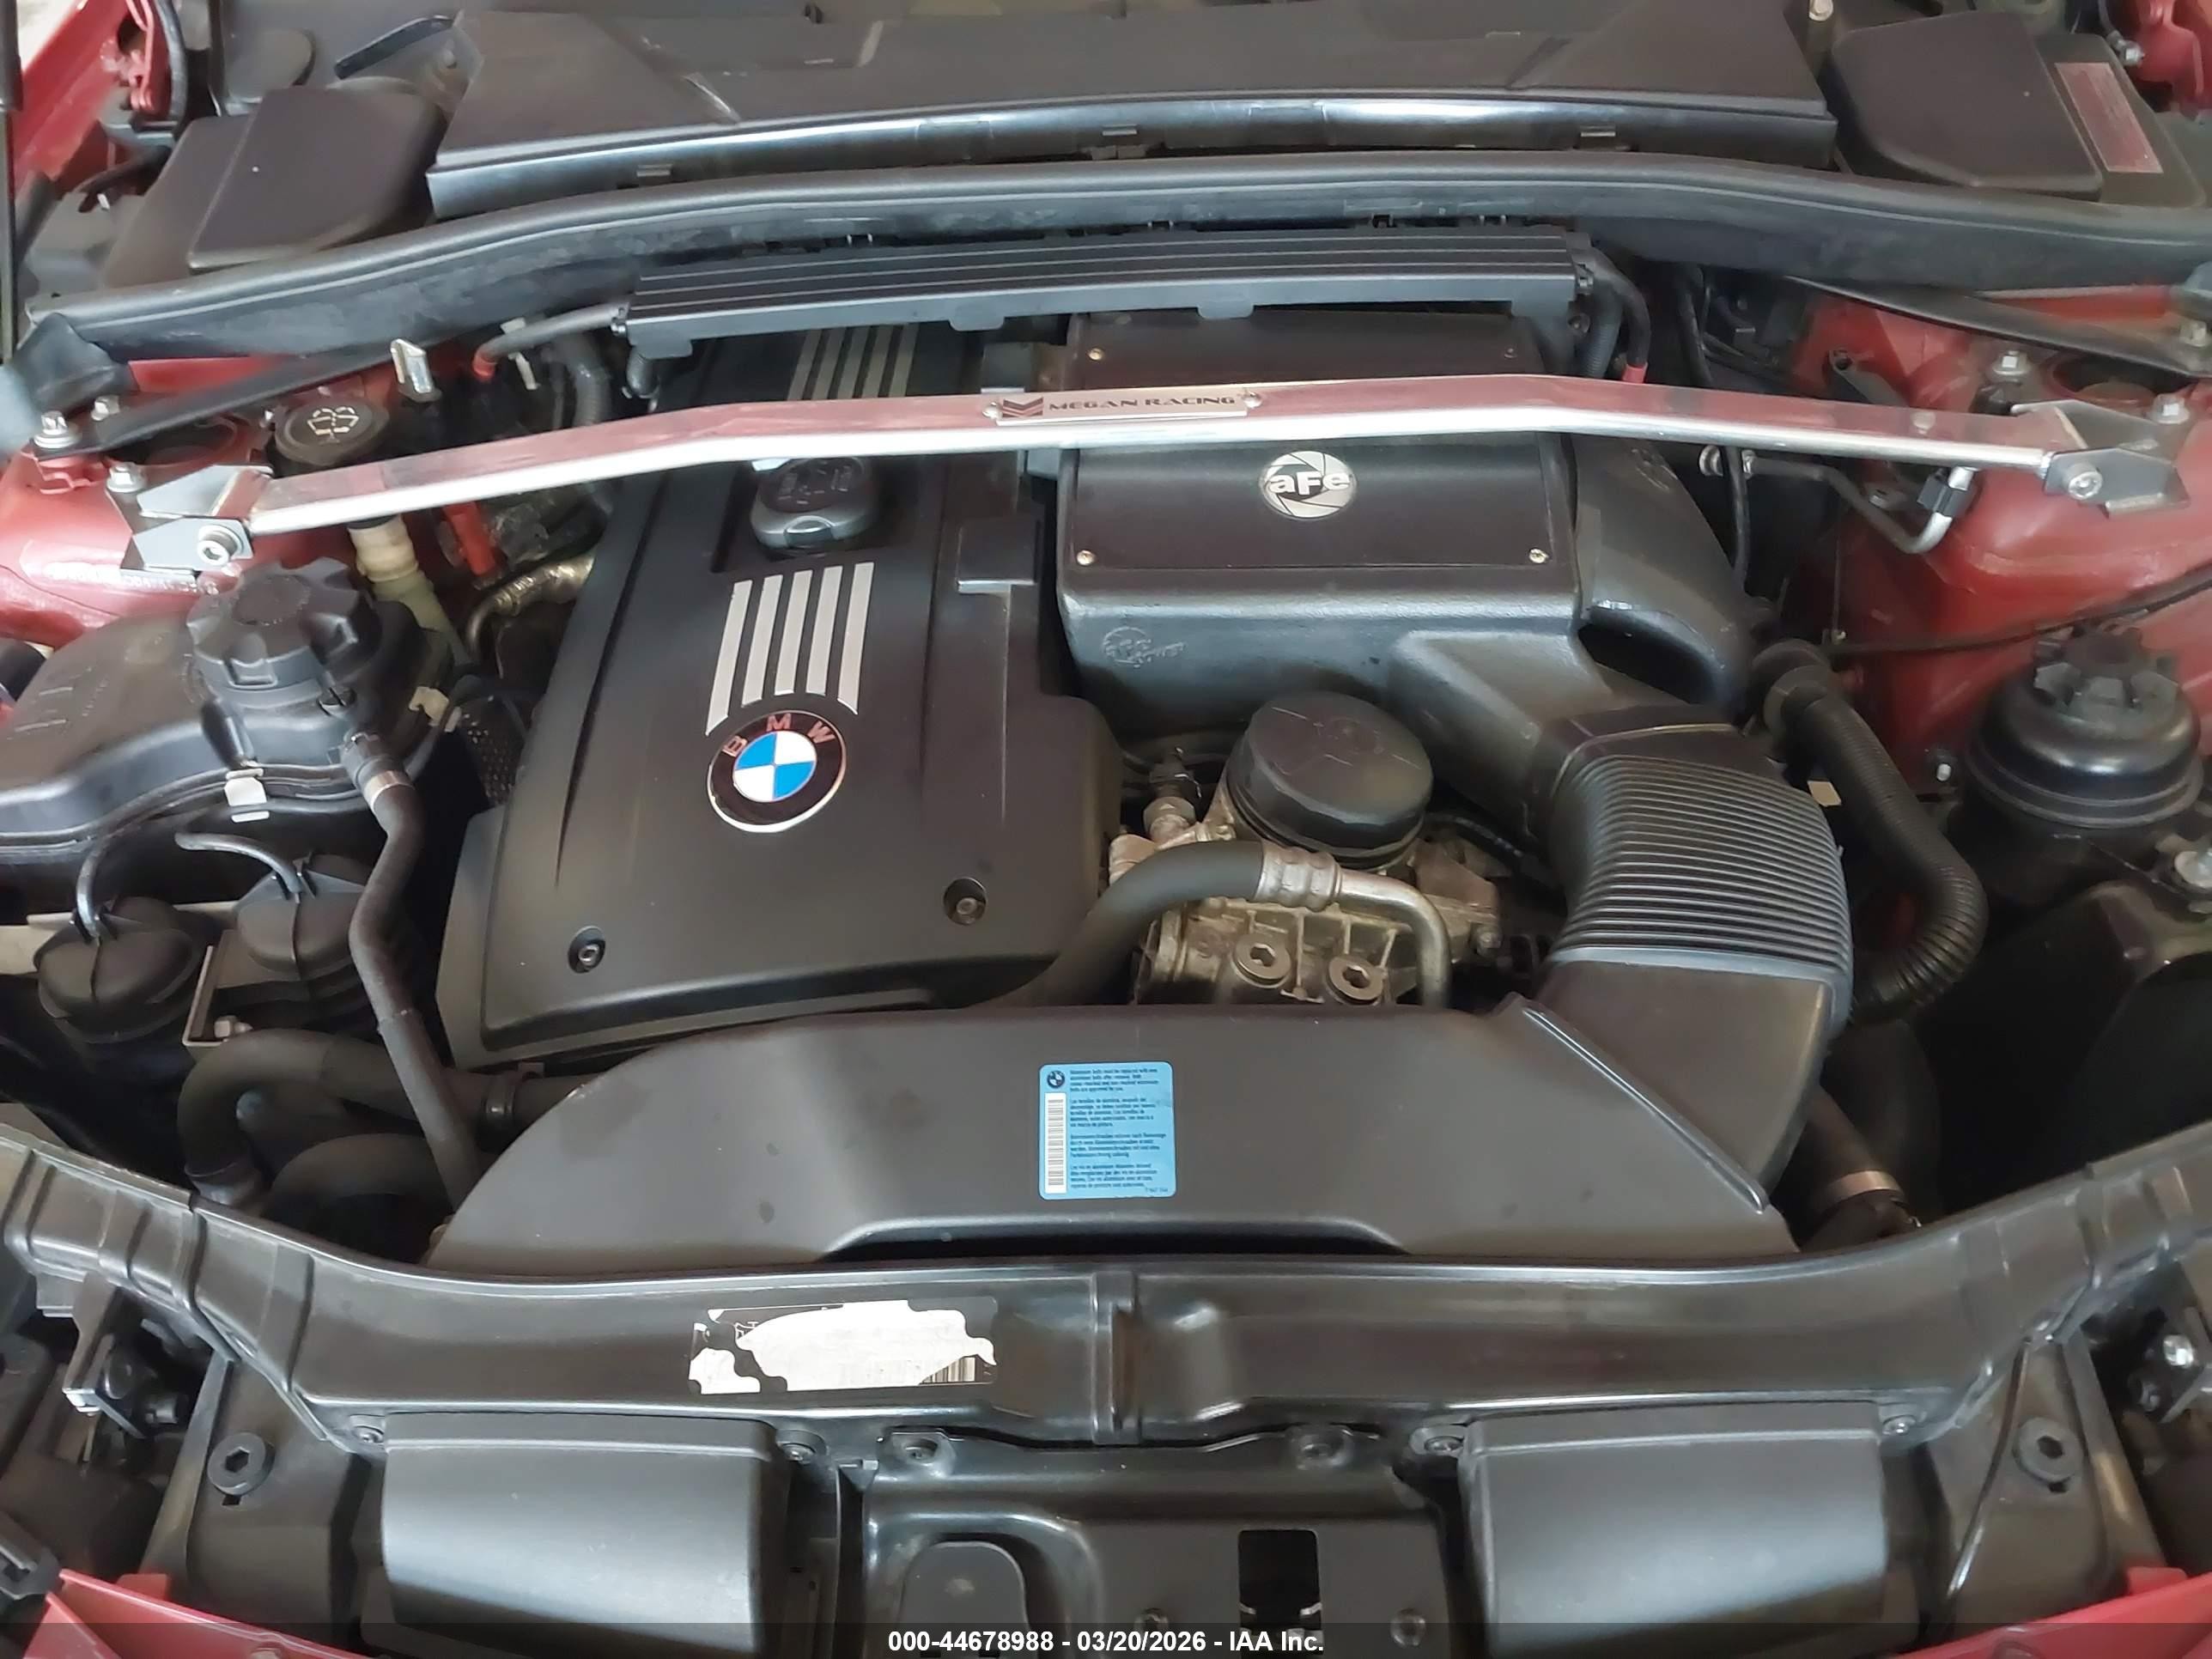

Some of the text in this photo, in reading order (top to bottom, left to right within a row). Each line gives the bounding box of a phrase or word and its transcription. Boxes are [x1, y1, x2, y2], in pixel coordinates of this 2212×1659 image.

[1048, 396, 1237, 410] MEGAN RACING
[1268, 471, 1351, 495] aFe
[722, 713, 836, 758] BMW
